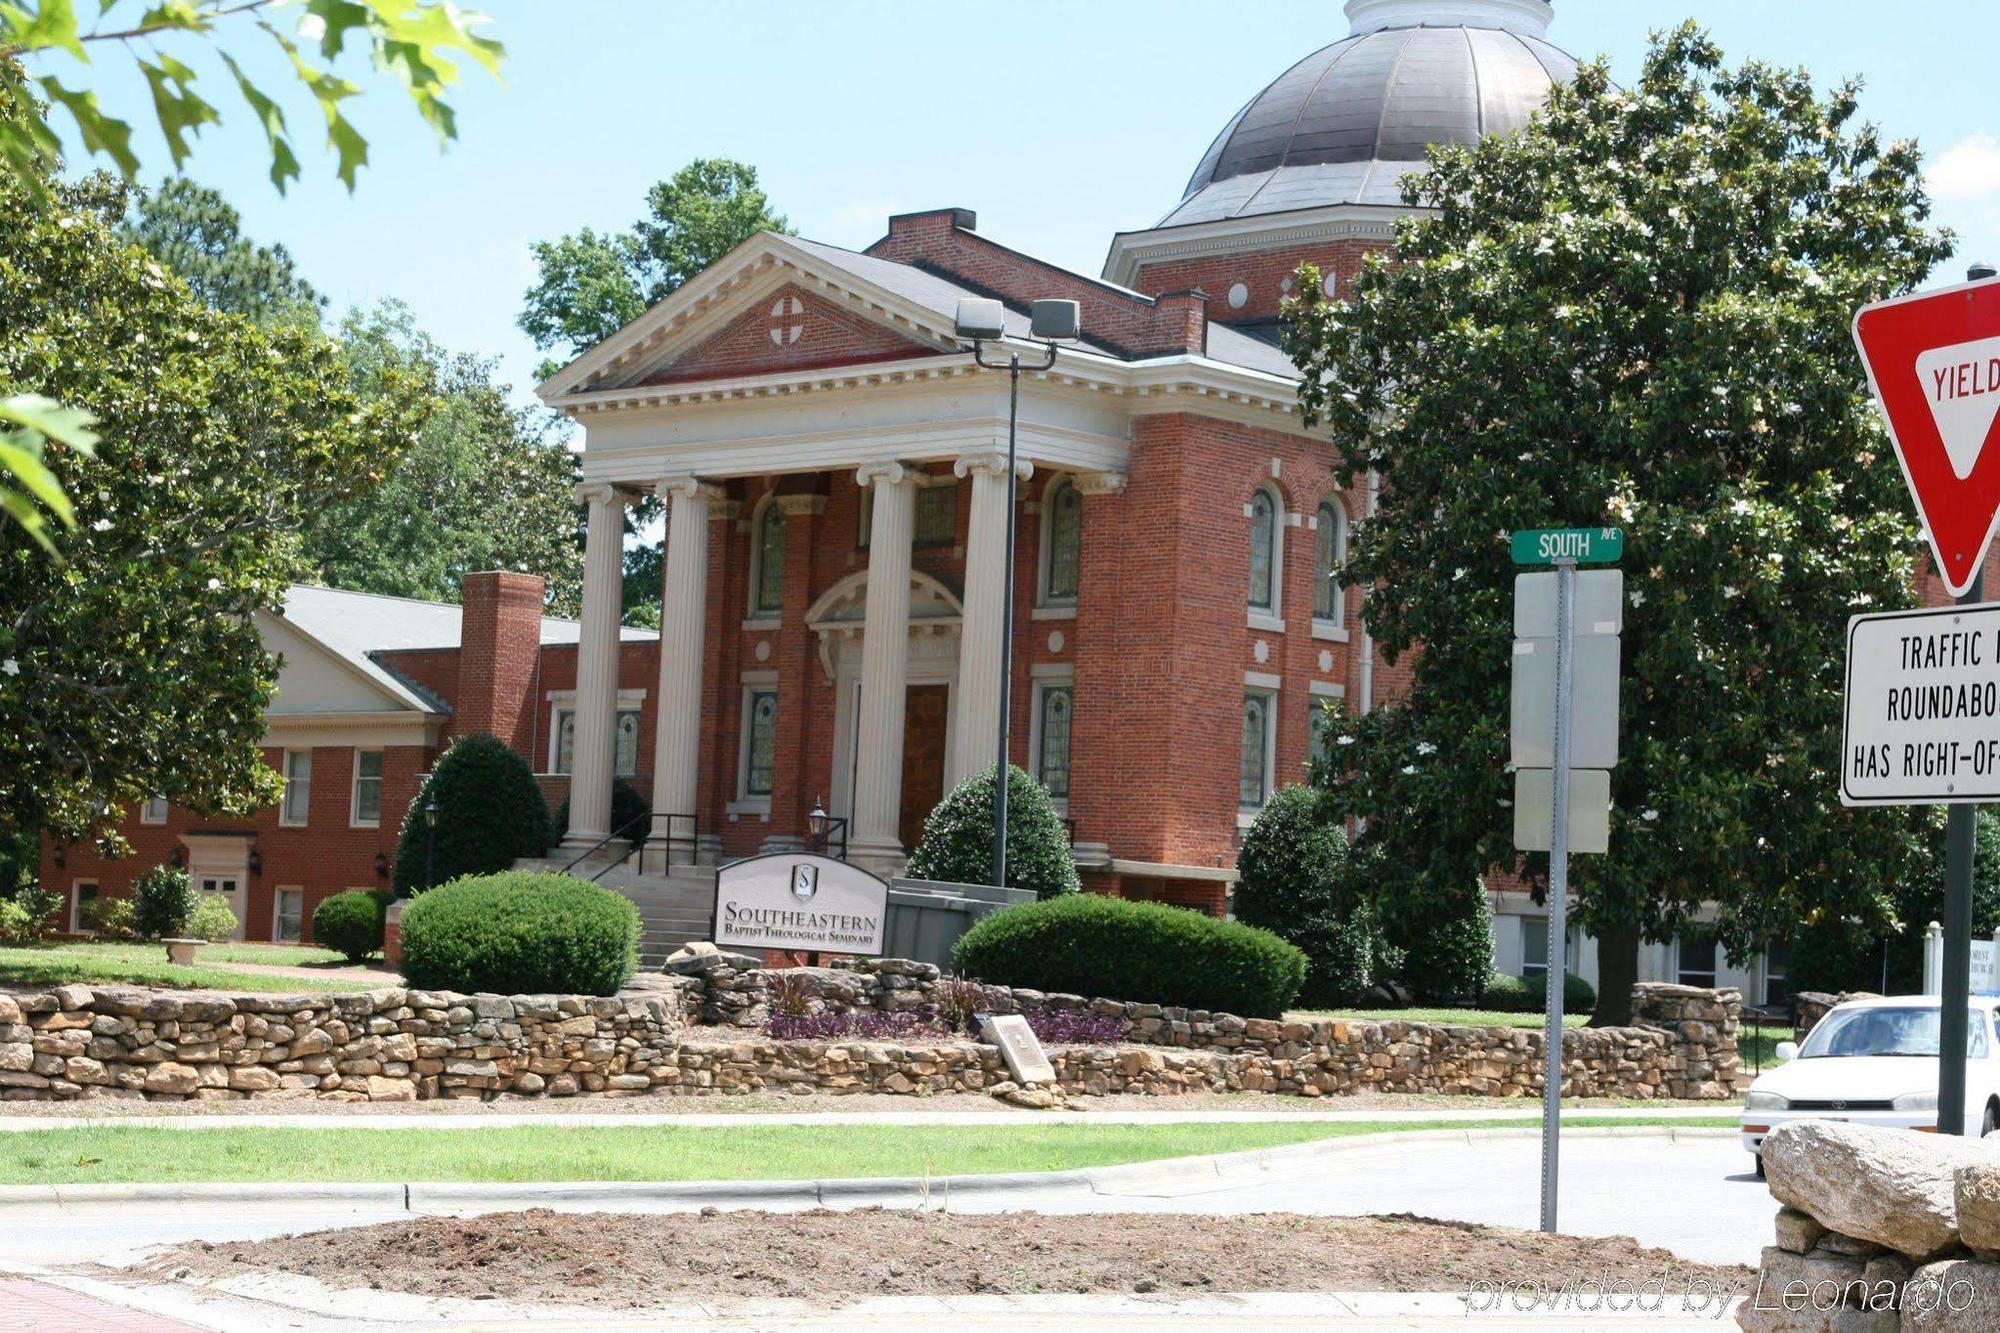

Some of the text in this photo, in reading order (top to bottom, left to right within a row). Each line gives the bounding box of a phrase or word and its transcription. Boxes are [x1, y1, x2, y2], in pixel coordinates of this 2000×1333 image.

[1933, 358, 2000, 401] YIELD
[1538, 527, 1617, 557] SOUTH AVE
[1901, 631, 1982, 669] TRAFFIC
[1887, 681, 2000, 721] ROUNDABO
[1853, 740, 2000, 778] HAS RIGHT-OF
[725, 901, 877, 932] SOUTHEASTERN
[725, 923, 875, 944] BAPTIST THEOLOGICAL SEMINARY
